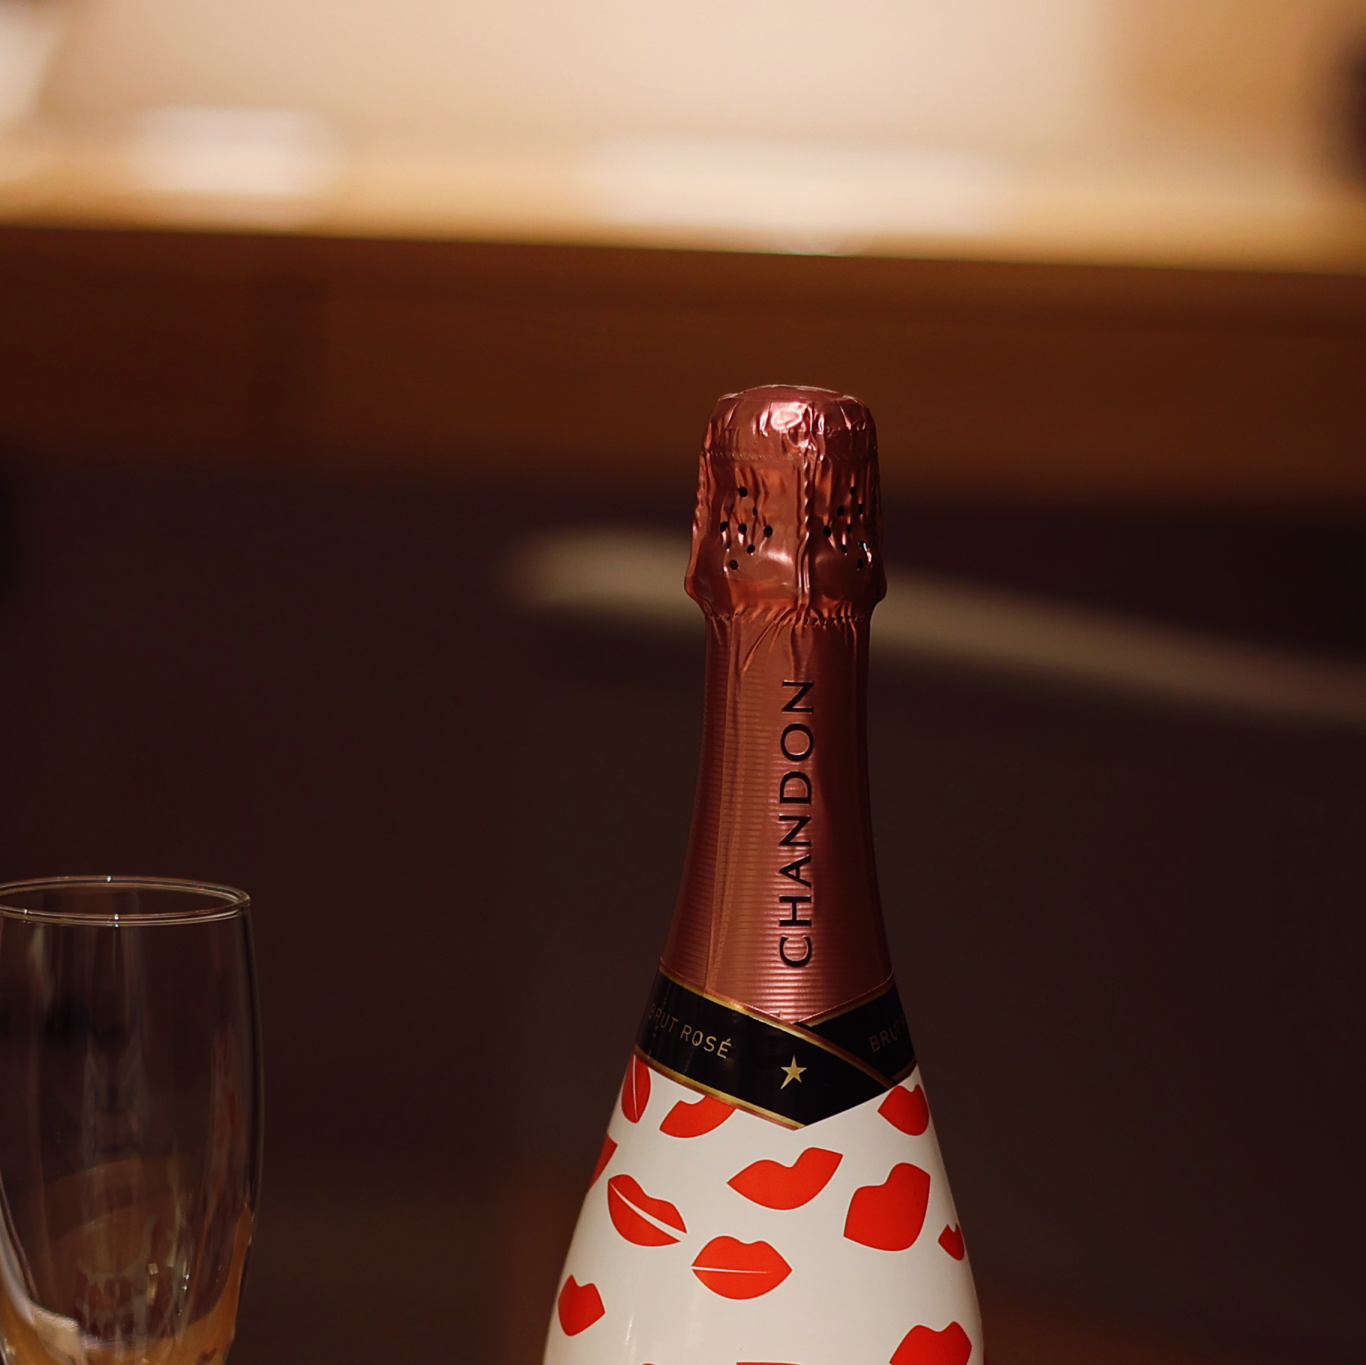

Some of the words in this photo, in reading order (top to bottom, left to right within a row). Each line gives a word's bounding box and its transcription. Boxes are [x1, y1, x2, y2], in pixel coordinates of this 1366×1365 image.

[778, 679, 815, 969] CHANDON
[647, 1002, 679, 1034] BRUT
[679, 1024, 733, 1060] ROSÉ
